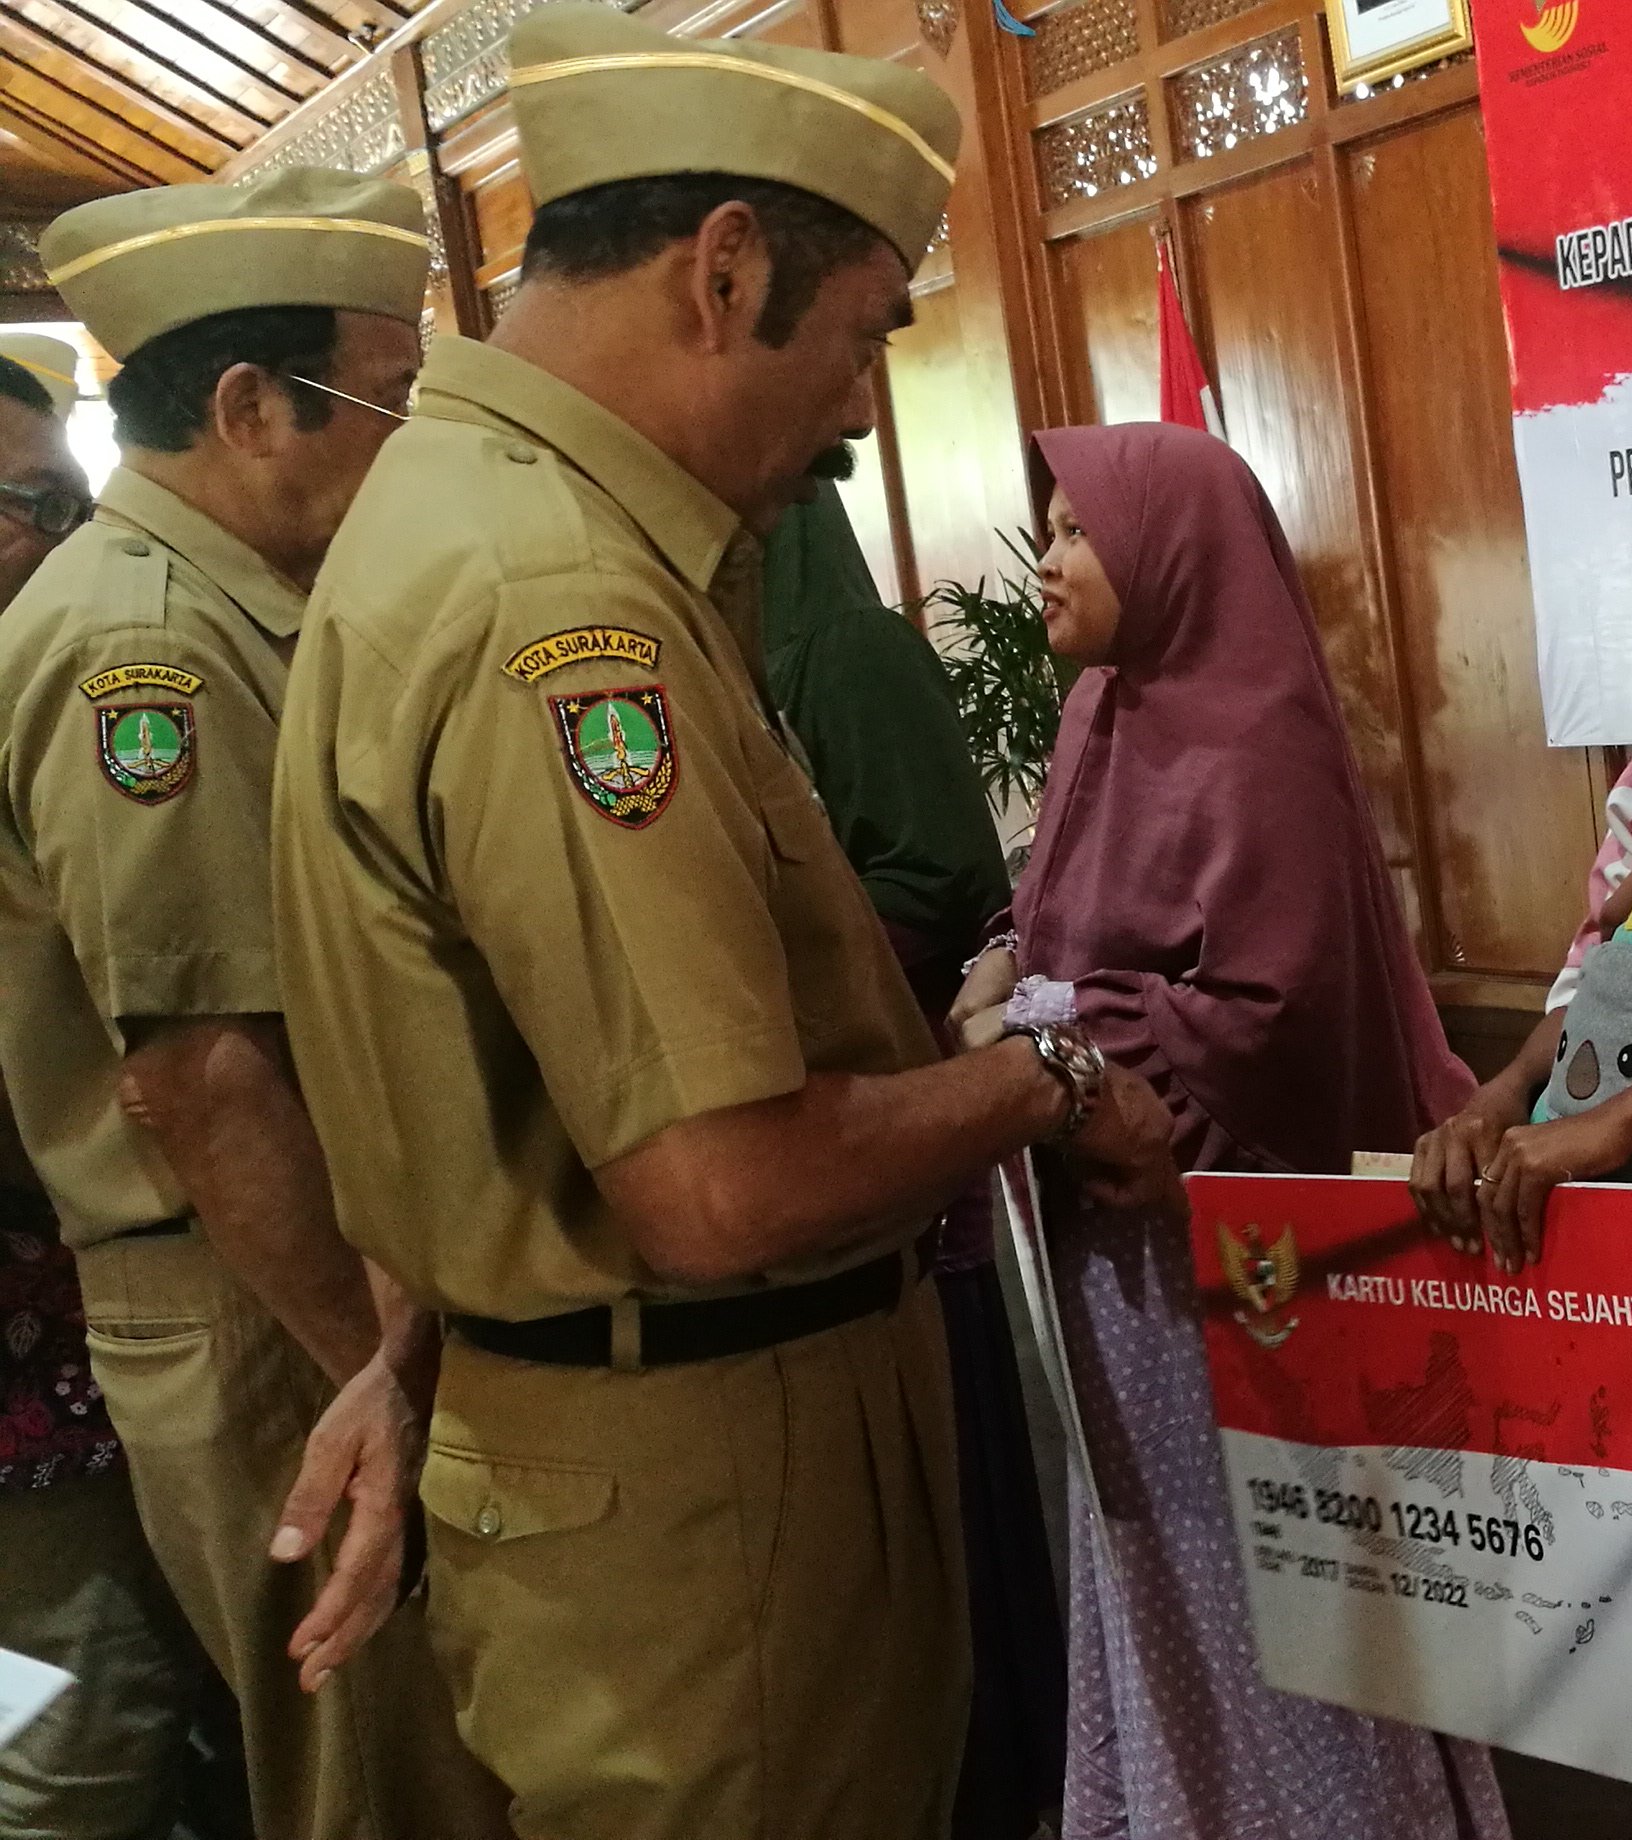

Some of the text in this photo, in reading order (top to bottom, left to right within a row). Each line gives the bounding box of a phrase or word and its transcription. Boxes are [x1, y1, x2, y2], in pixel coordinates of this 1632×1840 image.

[514, 632, 653, 678] KOTA SURAKARTA
[88, 667, 193, 694] KOTA SURAKARTA
[1326, 1272, 1405, 1306] KARTU
[1410, 1279, 1542, 1319] KELUARGA
[1390, 1501, 1460, 1546] 1234
[1467, 1512, 1546, 1562] 5676
